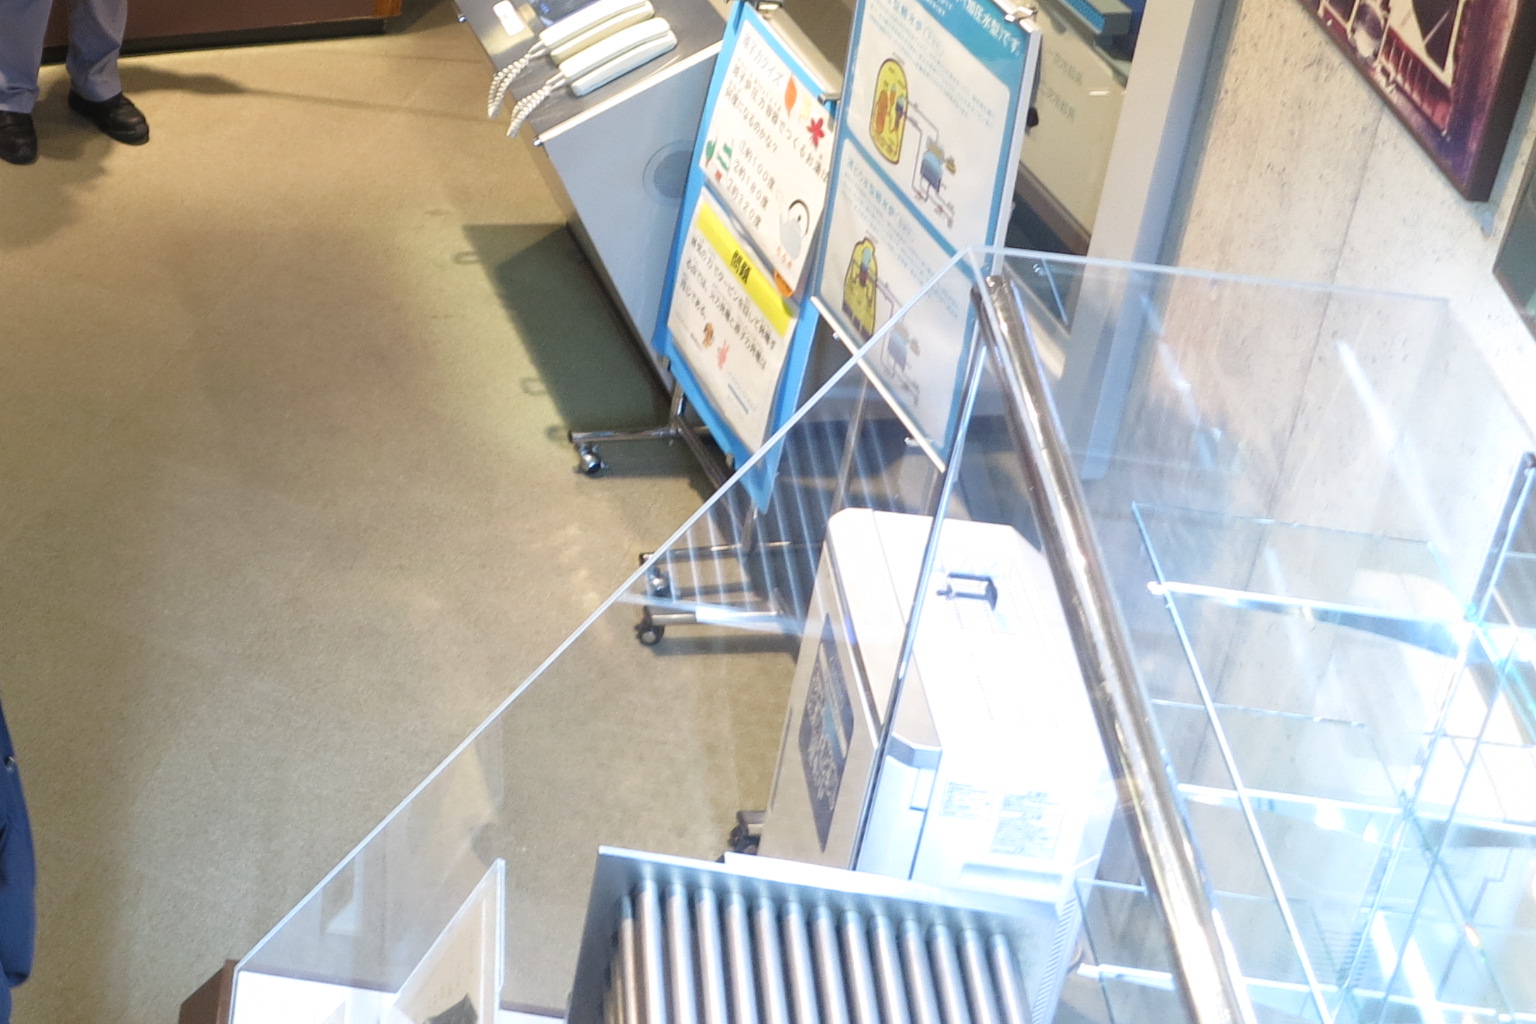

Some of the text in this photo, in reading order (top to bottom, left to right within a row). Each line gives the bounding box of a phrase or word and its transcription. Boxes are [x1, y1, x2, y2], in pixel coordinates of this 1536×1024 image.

[743, 33, 784, 86] 原子力クイズ
[730, 250, 751, 285] 問題
